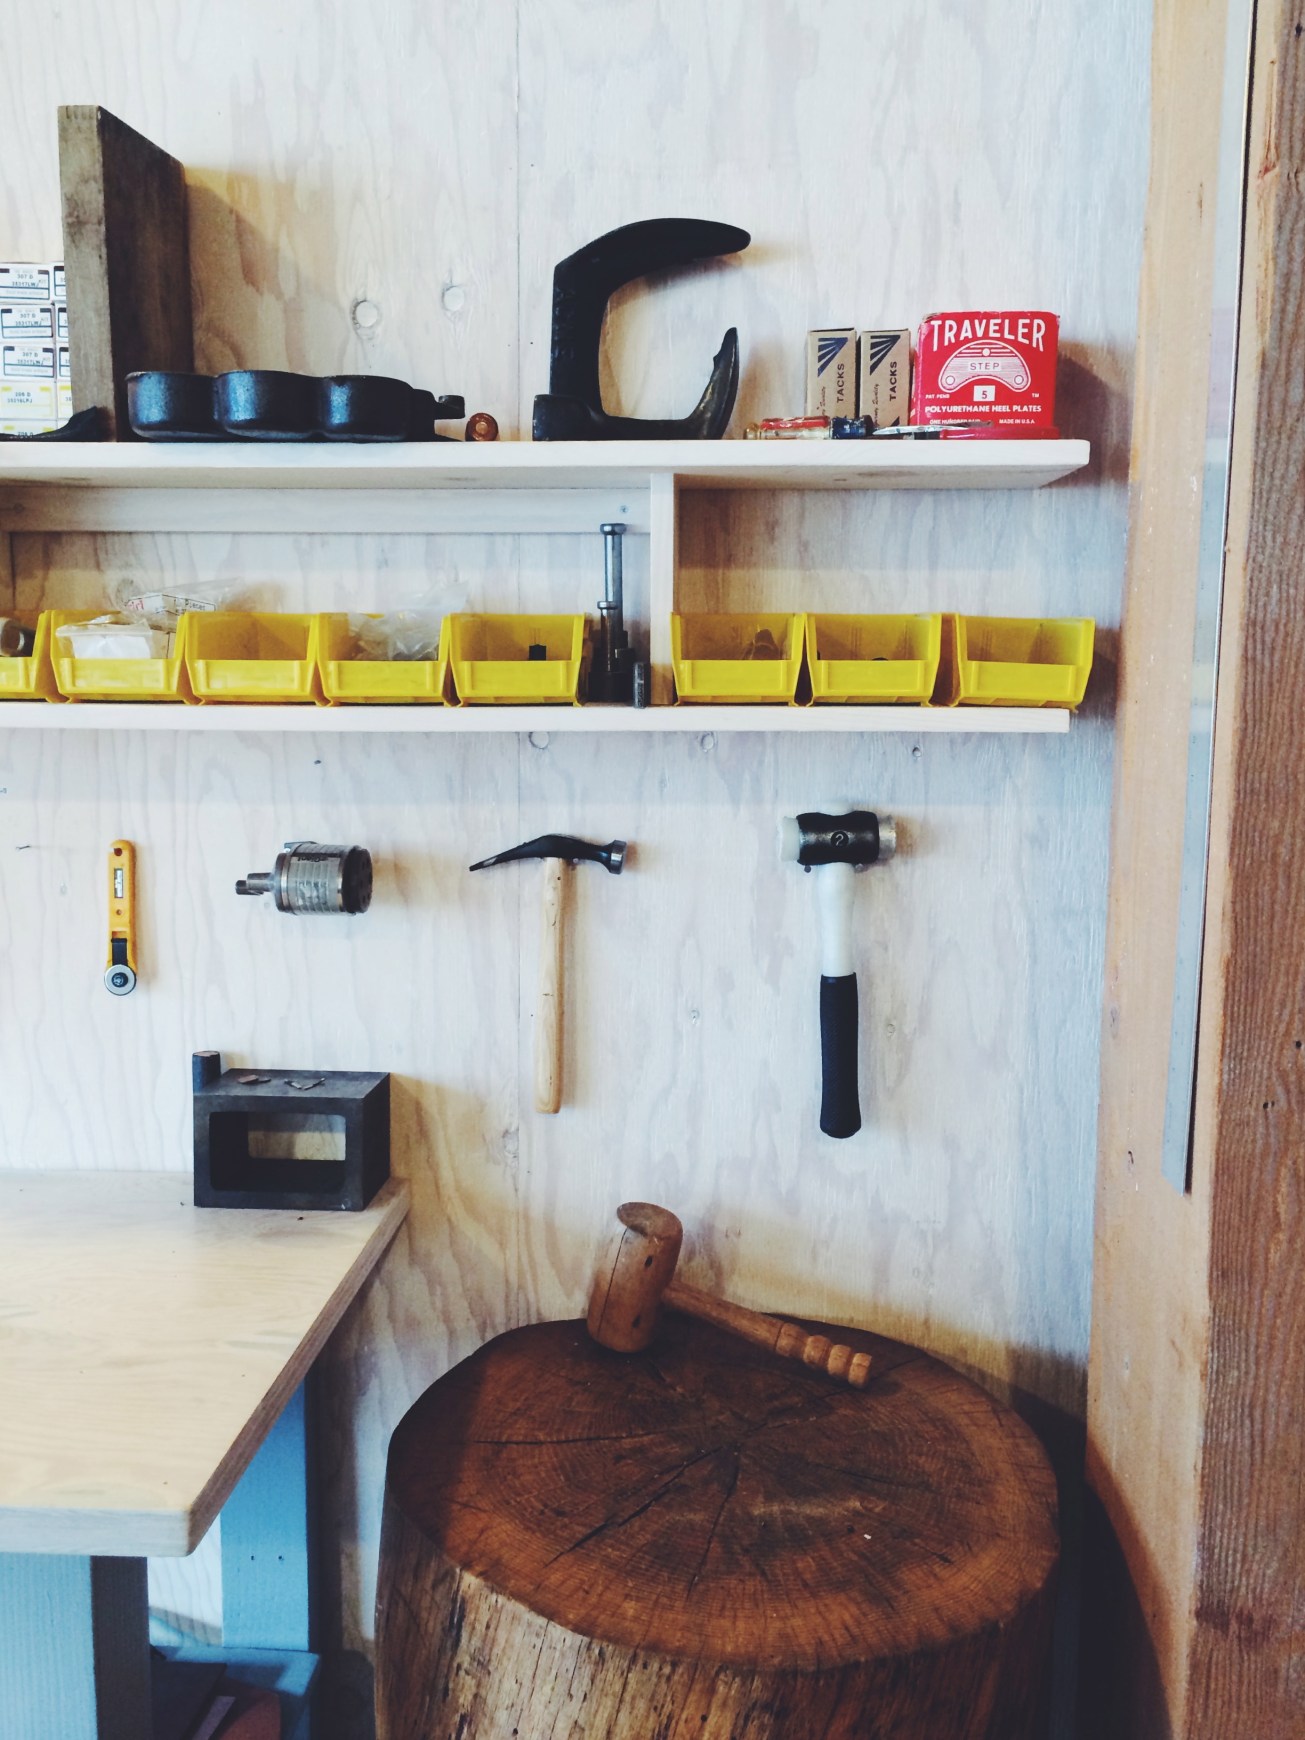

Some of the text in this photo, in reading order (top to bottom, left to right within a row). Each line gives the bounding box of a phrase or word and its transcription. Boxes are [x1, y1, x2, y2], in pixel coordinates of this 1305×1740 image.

[930, 318, 1046, 352] TRAVELER
[836, 363, 844, 404] TACKS
[889, 361, 897, 402] TACKS
[969, 362, 1000, 371] STEP
[981, 390, 988, 400] 5
